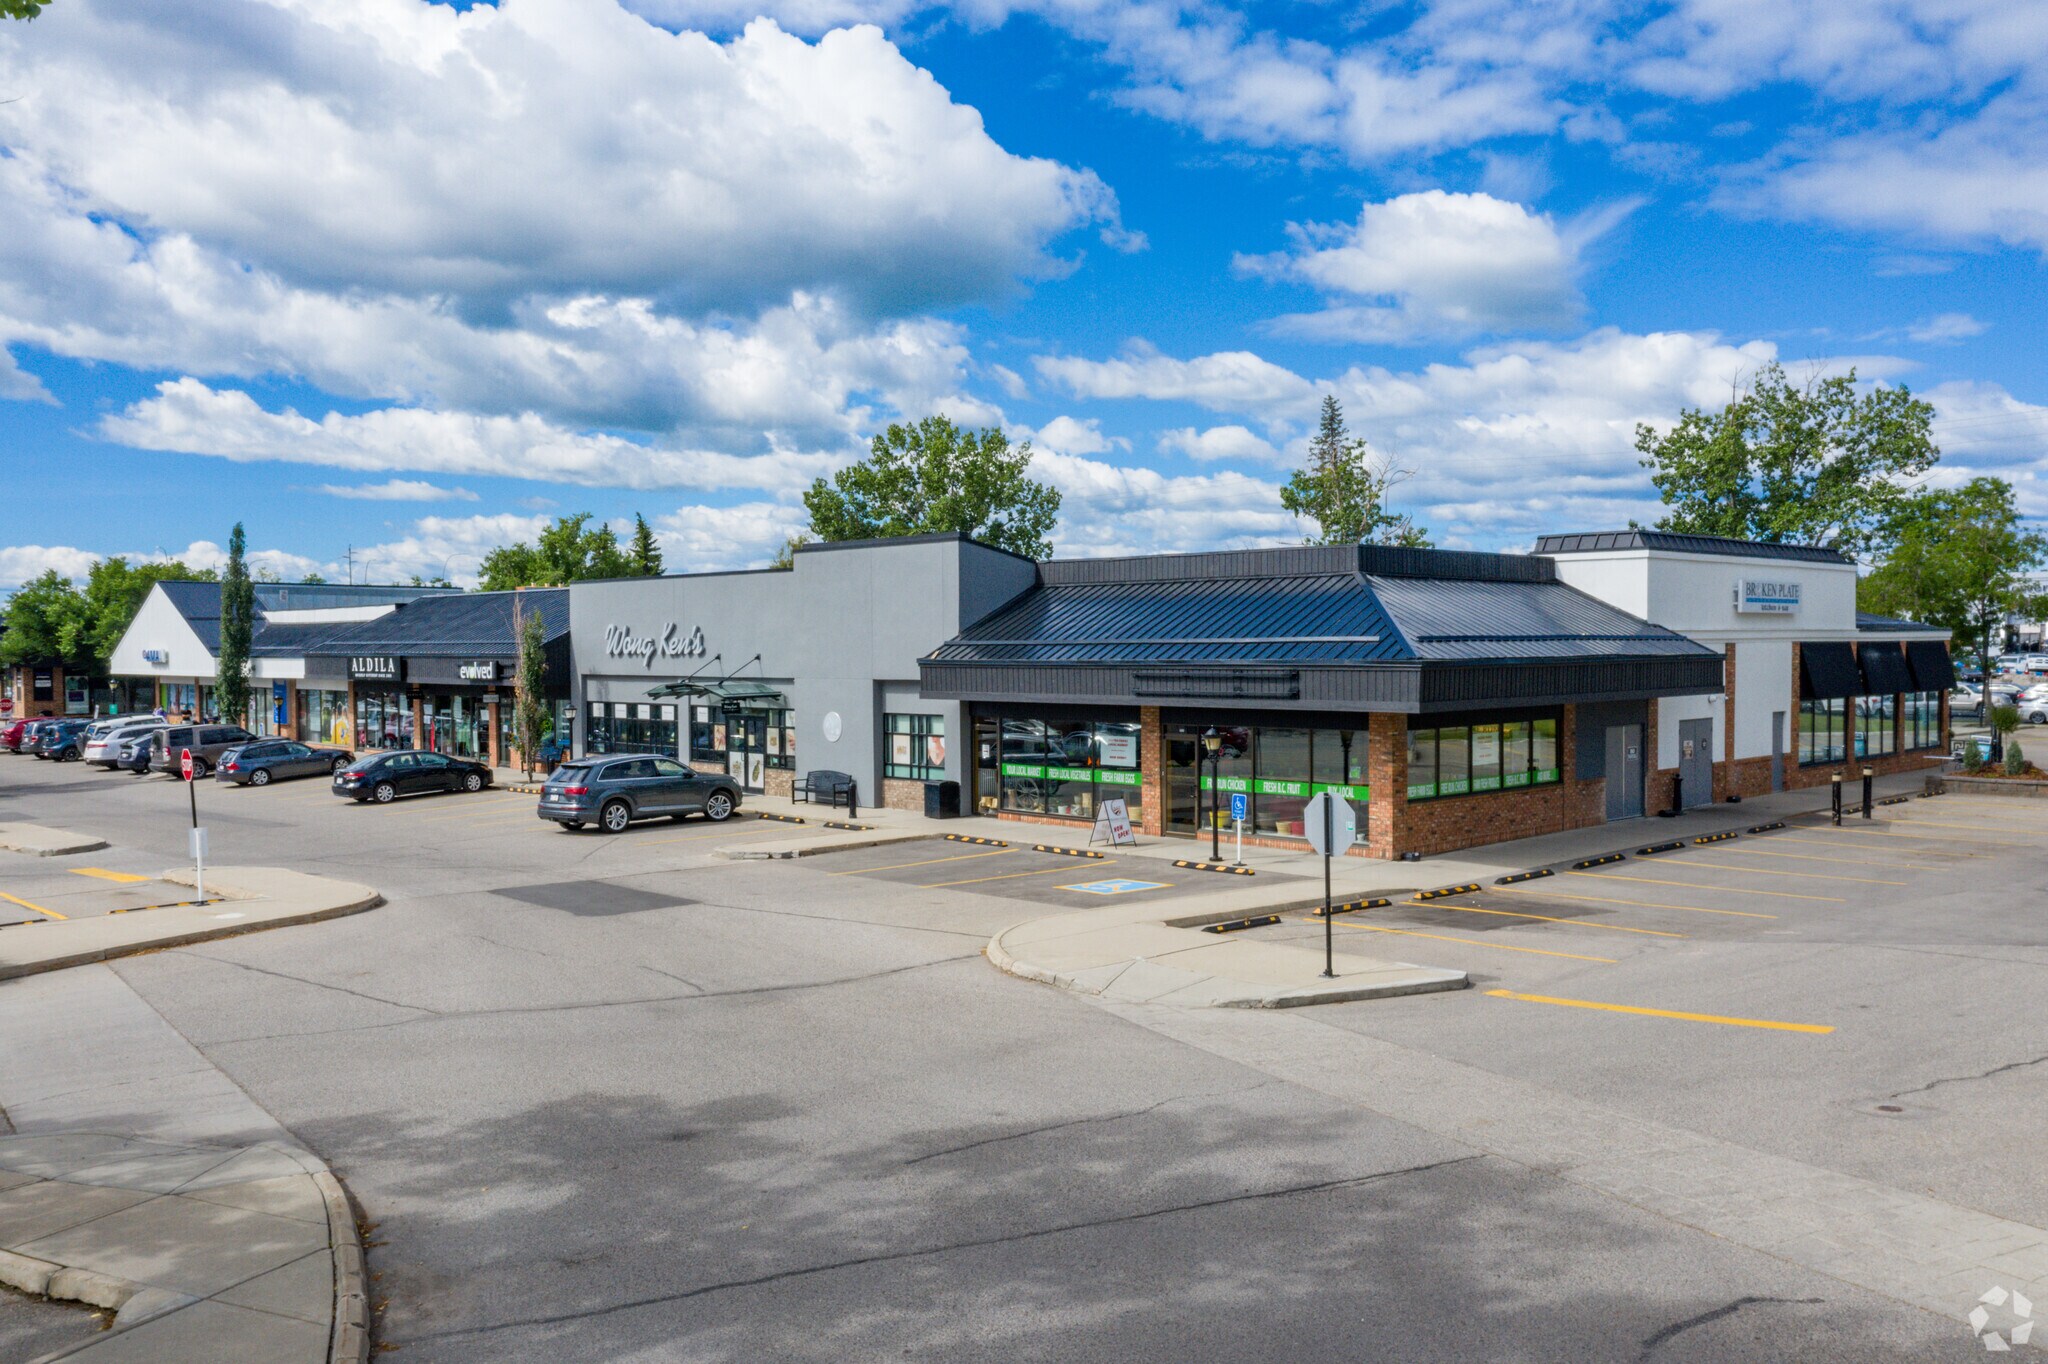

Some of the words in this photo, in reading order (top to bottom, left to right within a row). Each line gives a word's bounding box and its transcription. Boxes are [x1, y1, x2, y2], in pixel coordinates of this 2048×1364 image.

[1746, 582, 1777, 597] BRKEN
[1778, 584, 1800, 598] PLATE
[605, 623, 655, 668] Wong
[659, 622, 705, 656] Ken's
[351, 657, 395, 673] ALDILA
[460, 661, 494, 679] evolved
[1016, 766, 1027, 776] LOCAL
[1049, 768, 1059, 778] FRESH
[1060, 769, 1070, 779] LOCAL
[1102, 771, 1113, 781] FRESH
[1113, 772, 1124, 783] FARM
[1125, 773, 1135, 784] EGGS
[1227, 779, 1246, 790] CHICKEN
[1263, 781, 1277, 793] FRESH
[1287, 783, 1300, 795] FRUIT
[1340, 786, 1355, 798] LOCAL
